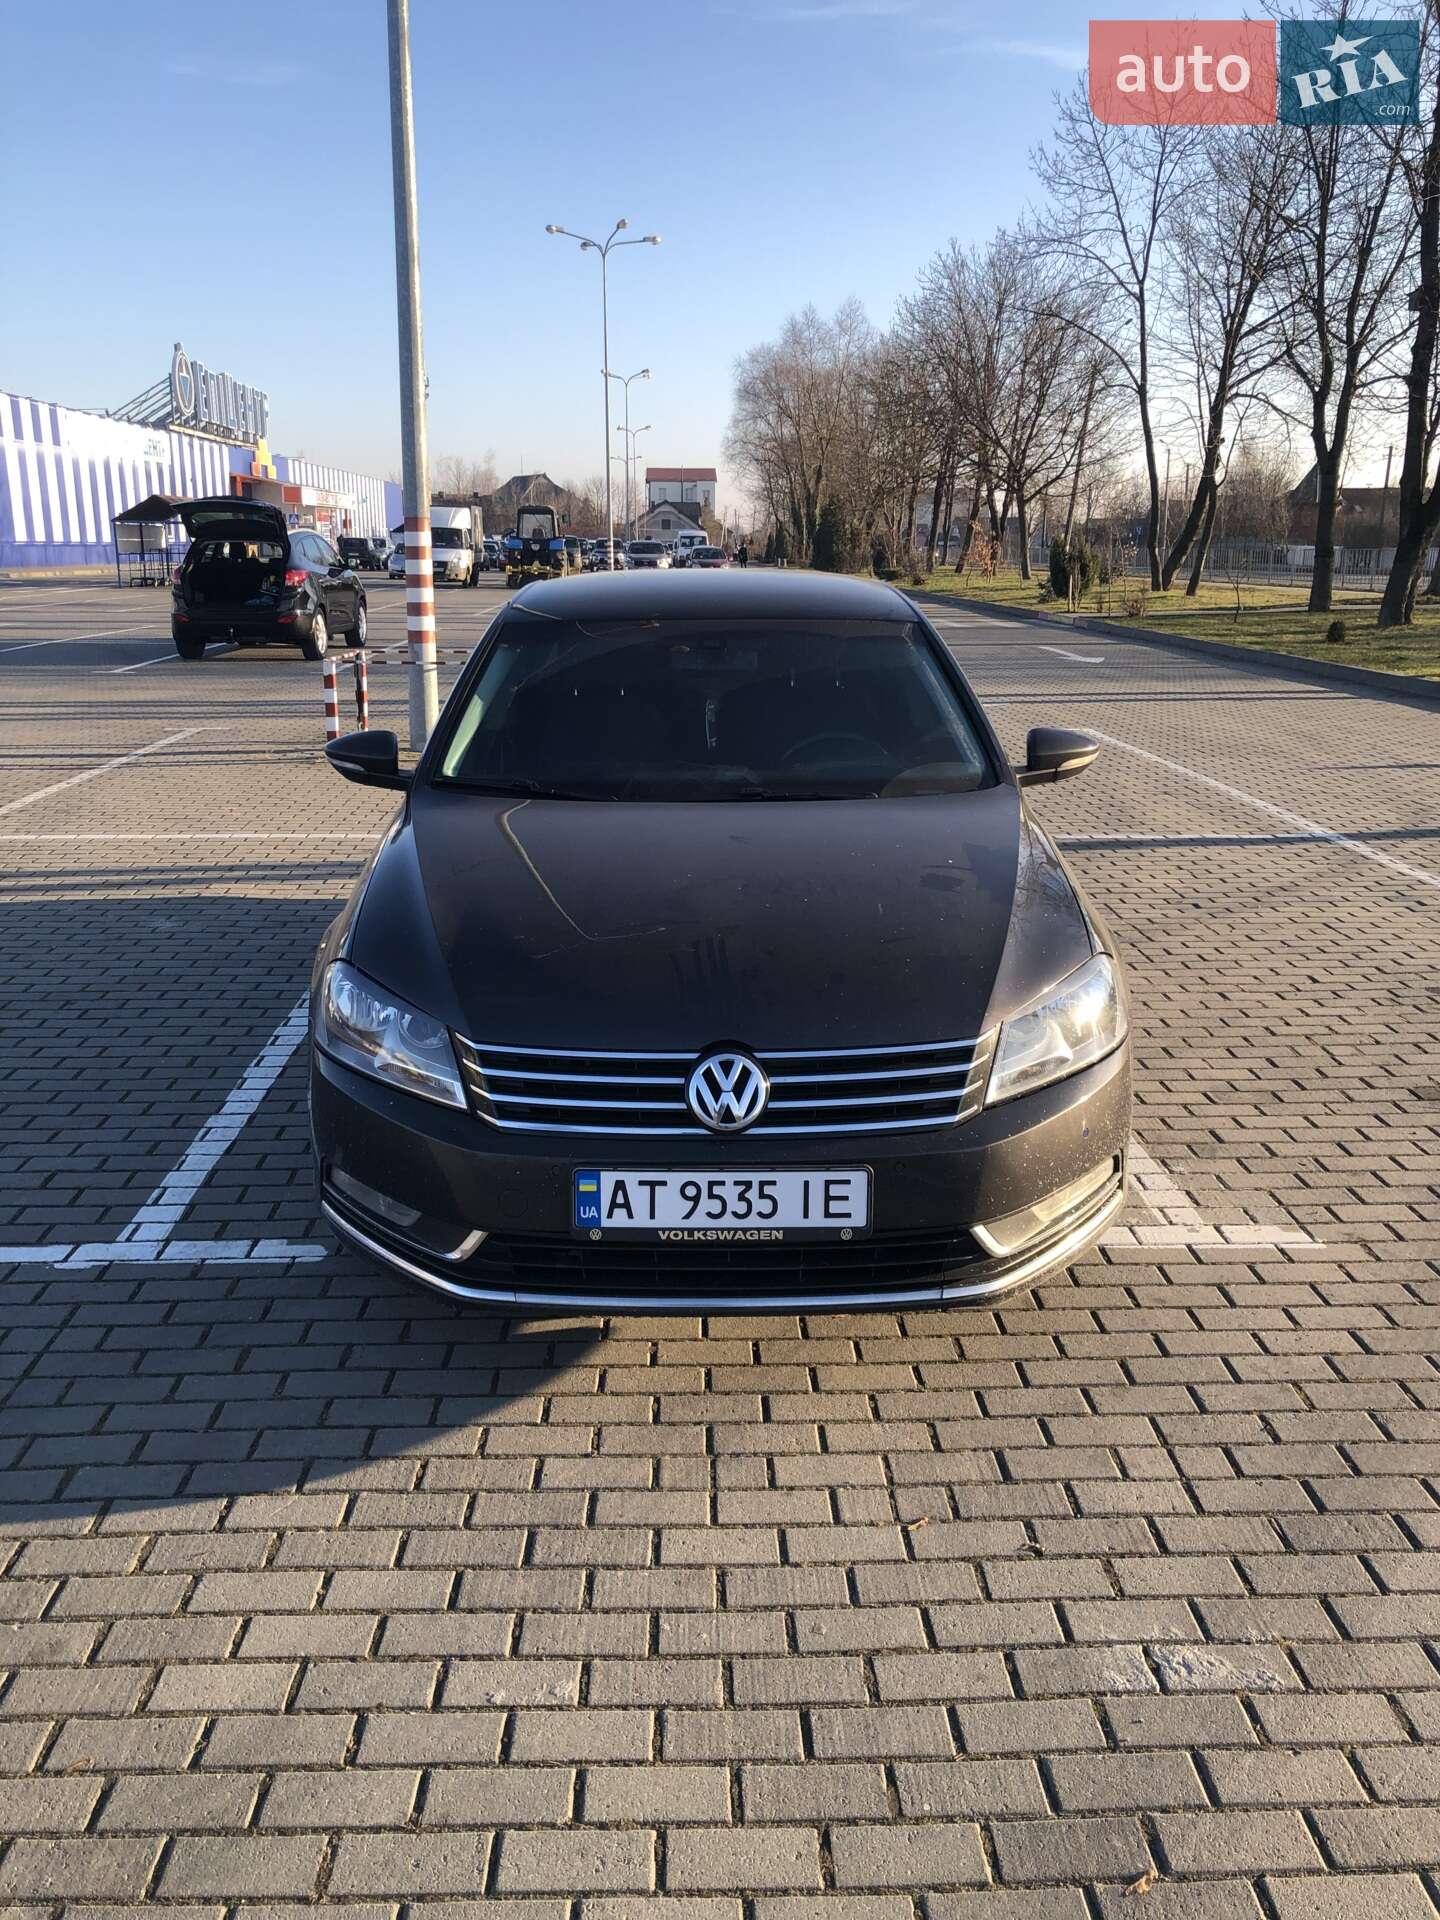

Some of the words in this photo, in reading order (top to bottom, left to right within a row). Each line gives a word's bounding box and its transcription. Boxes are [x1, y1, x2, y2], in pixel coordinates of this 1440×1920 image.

[606, 1179, 668, 1220] AT
[679, 1179, 779, 1220] 9535
[803, 1179, 852, 1220] IE
[580, 1206, 599, 1219] UA
[658, 1229, 784, 1241] VOLKSWAGEN
